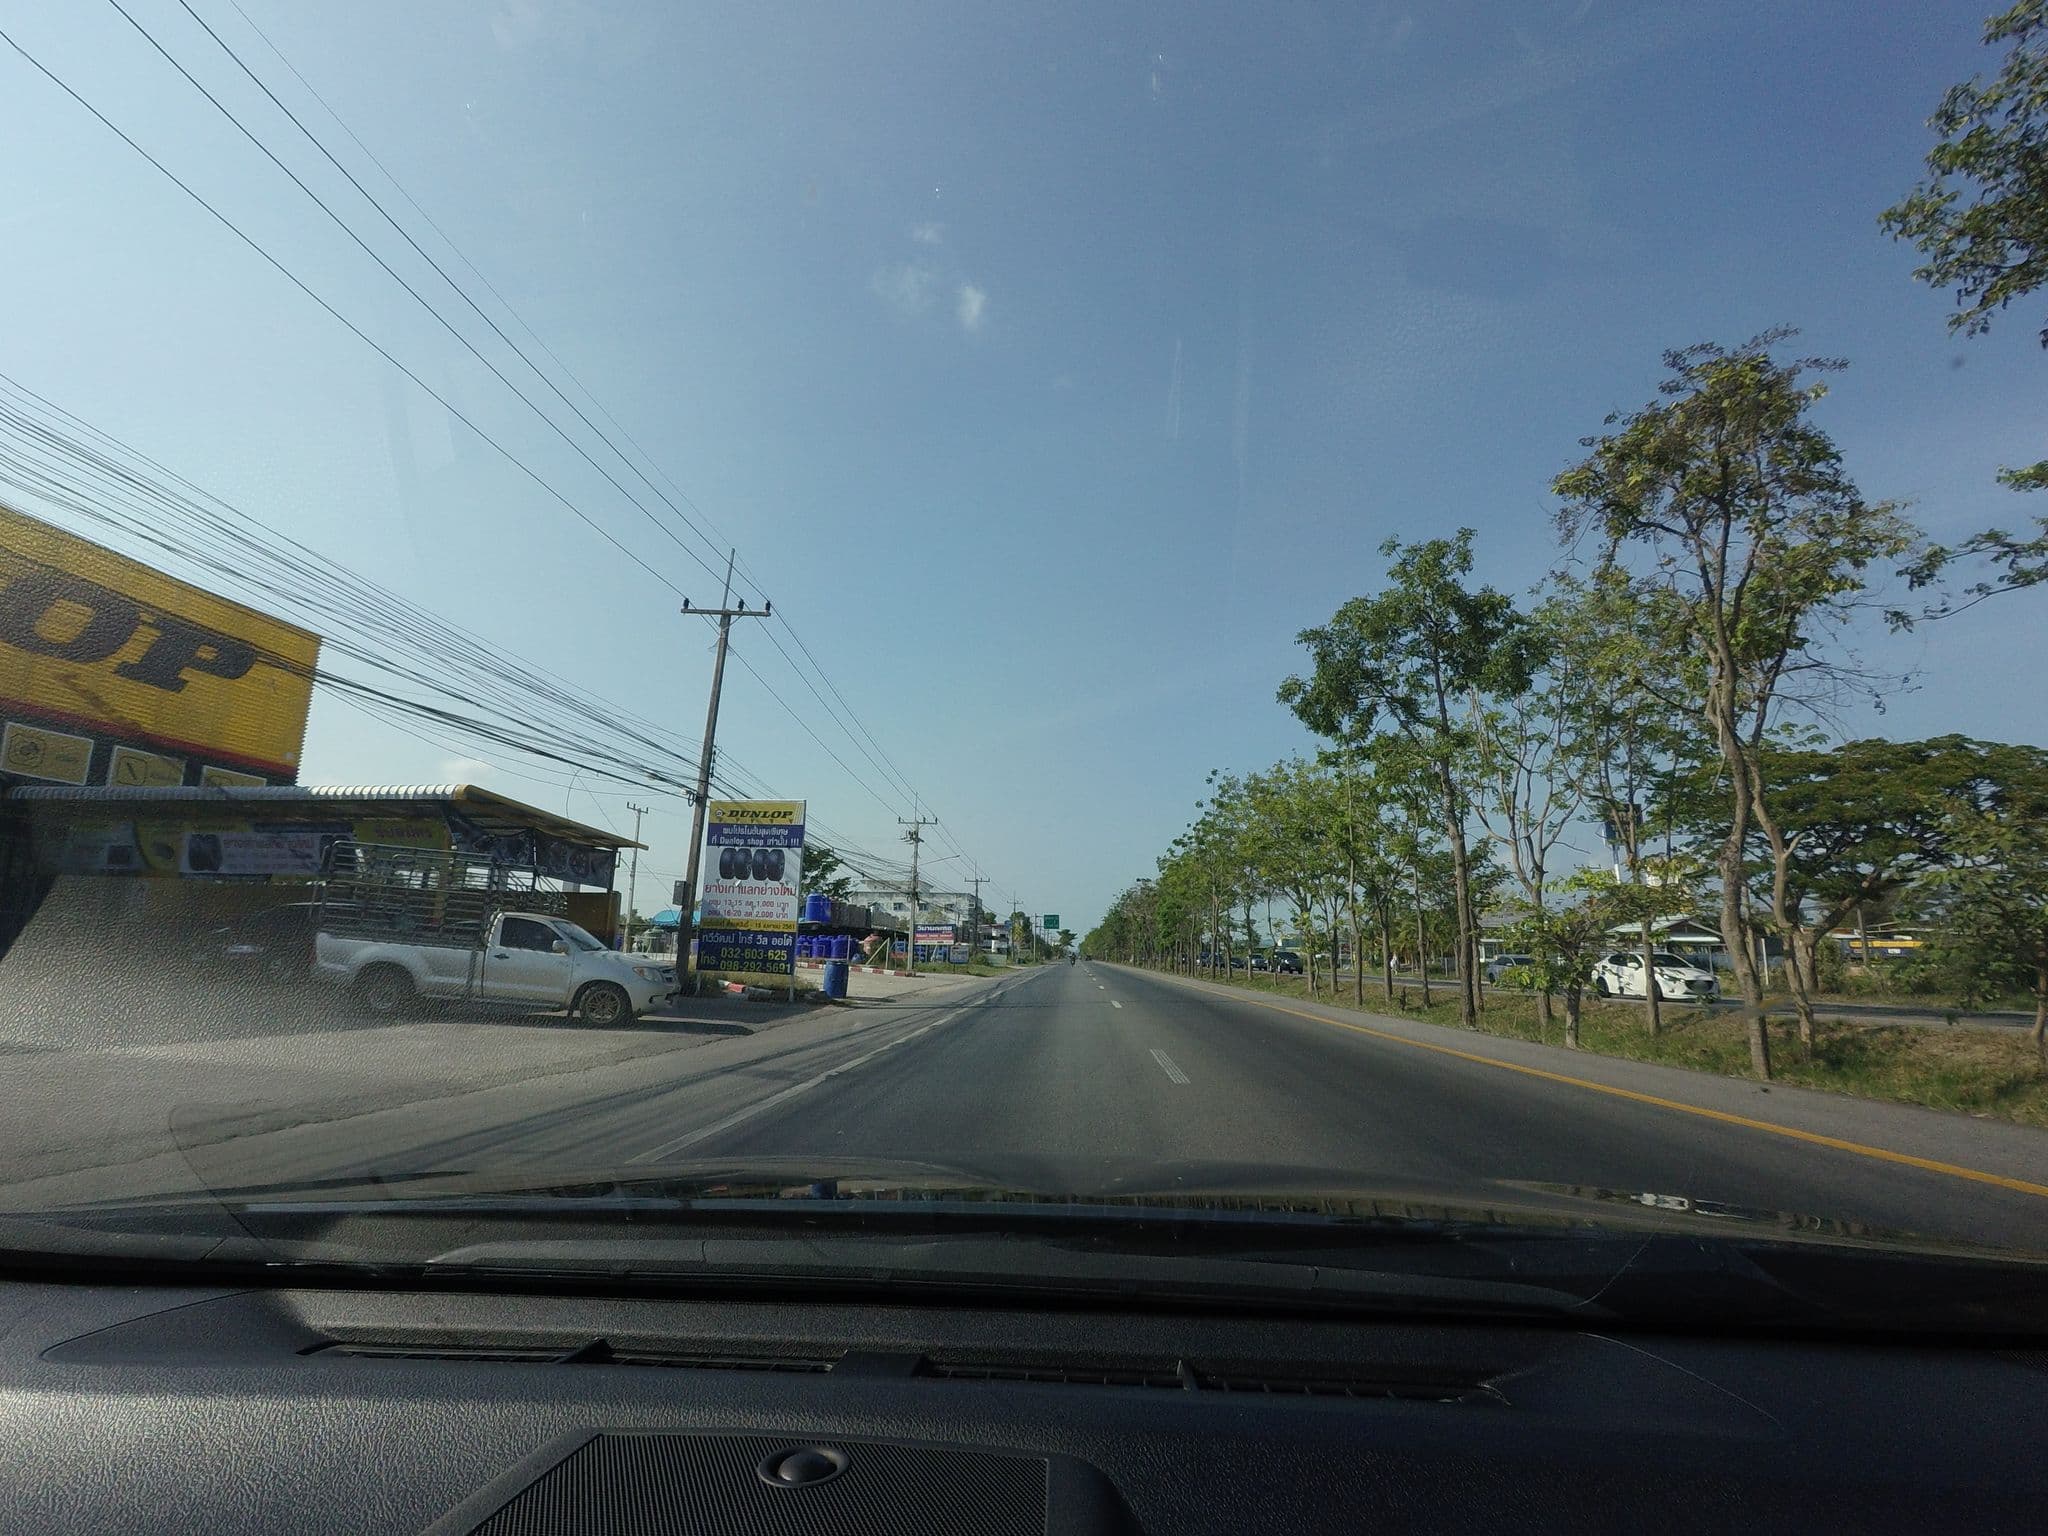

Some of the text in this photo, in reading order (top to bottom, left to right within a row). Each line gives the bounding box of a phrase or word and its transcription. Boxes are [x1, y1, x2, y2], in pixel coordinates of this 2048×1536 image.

[727, 809, 794, 819] DUNLOP
[719, 836, 745, 846] Dunlop
[747, 837, 764, 846] shop
[720, 948, 788, 961] 032-603-625
[719, 960, 791, 974] 098-292-5691
